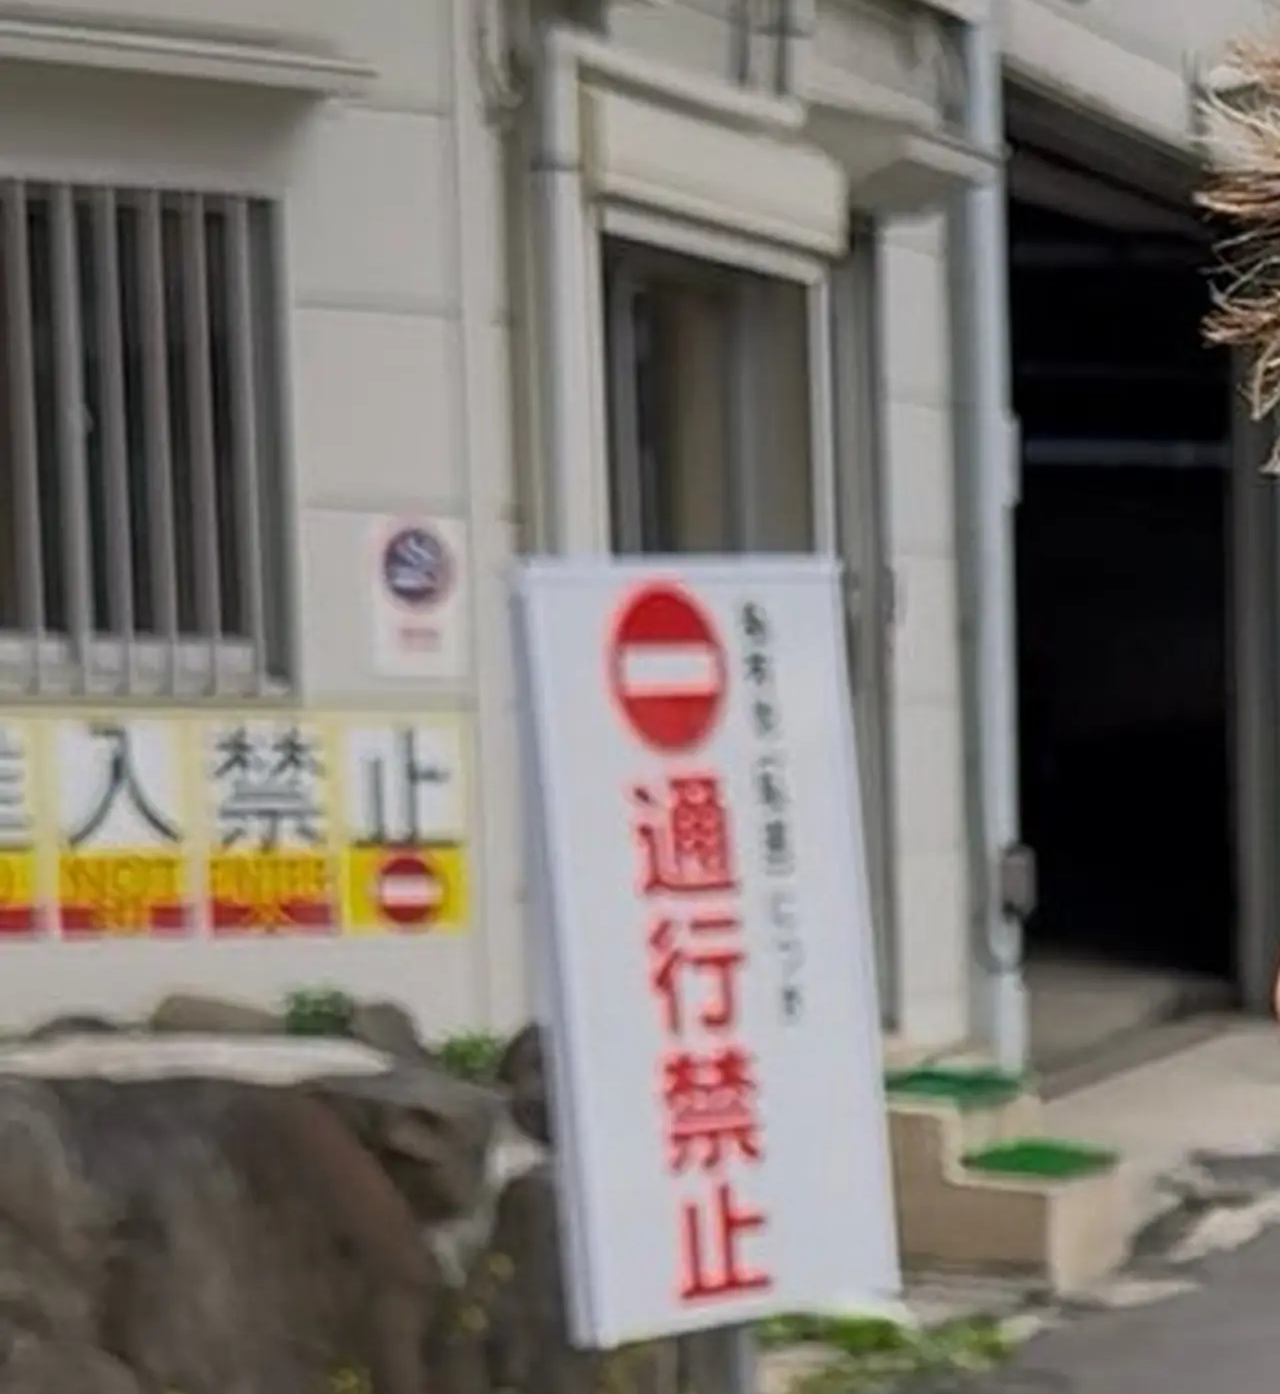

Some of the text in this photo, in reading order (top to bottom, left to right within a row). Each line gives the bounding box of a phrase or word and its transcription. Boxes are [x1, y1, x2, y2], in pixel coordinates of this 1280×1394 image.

[0, 718, 460, 849] 入禁止
[633, 777, 771, 1299] 通行禁止
